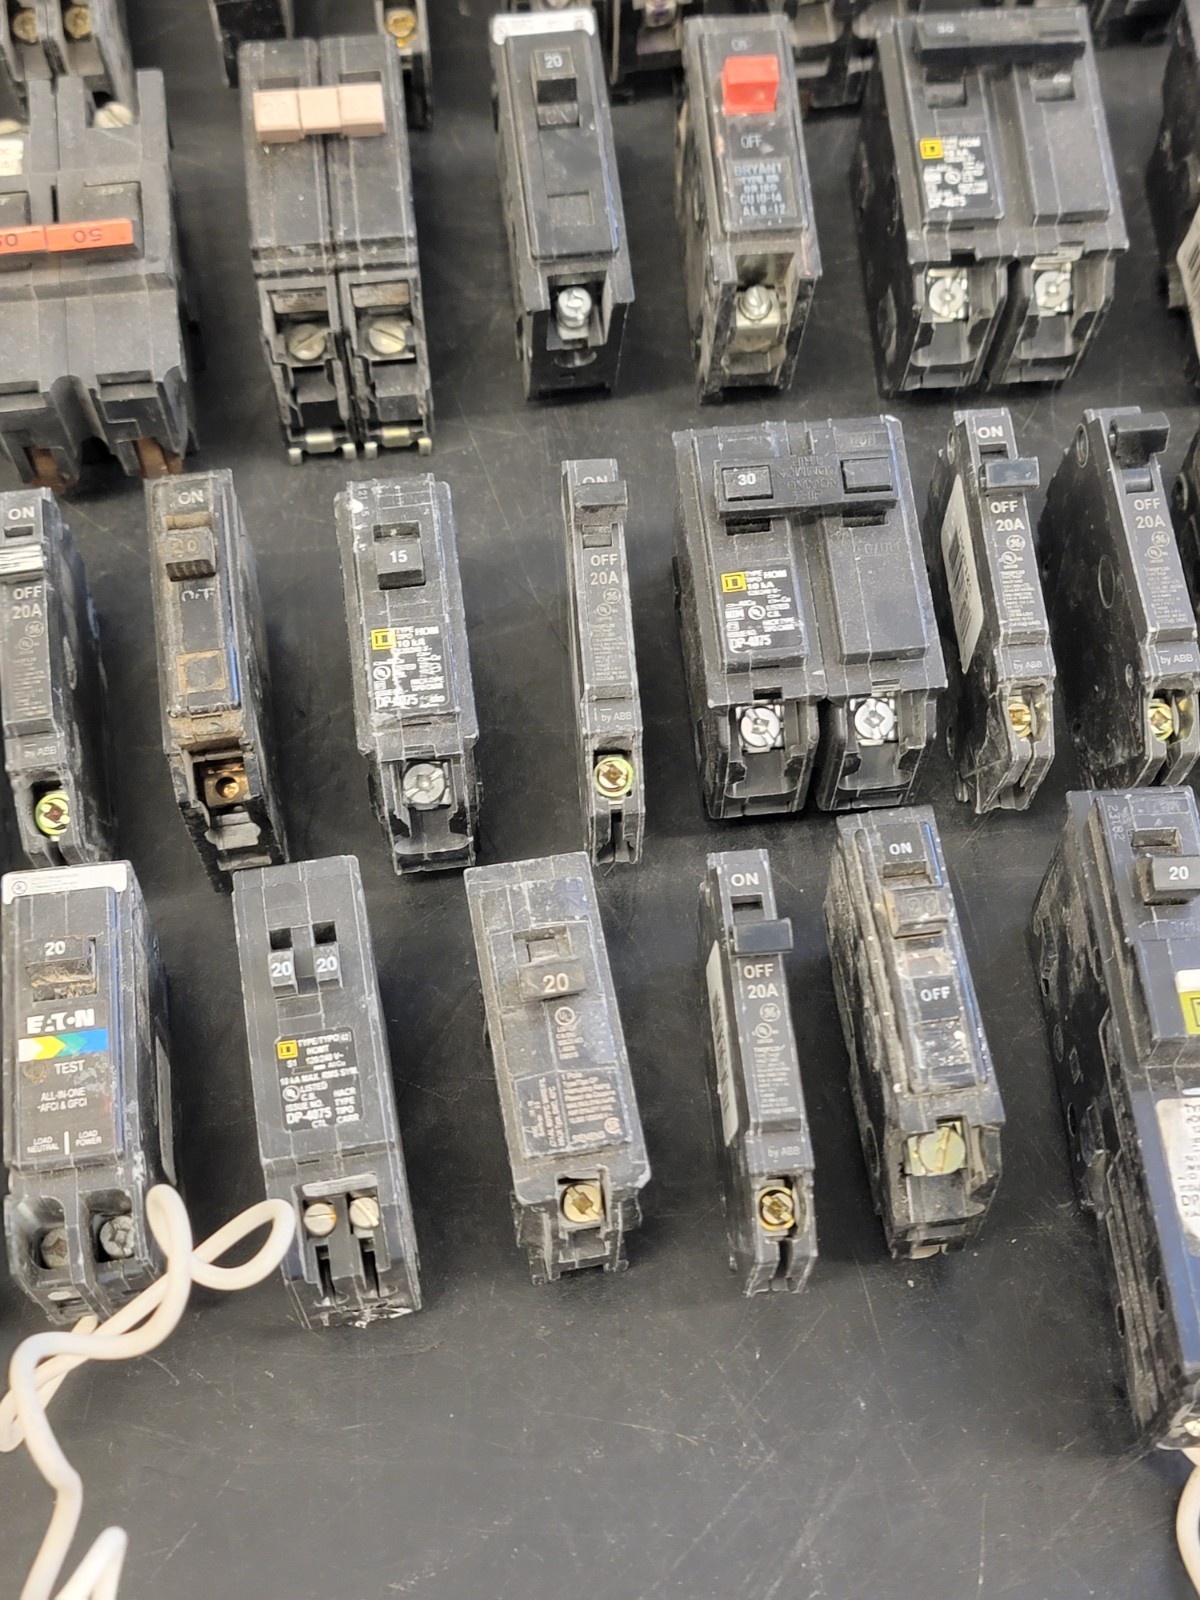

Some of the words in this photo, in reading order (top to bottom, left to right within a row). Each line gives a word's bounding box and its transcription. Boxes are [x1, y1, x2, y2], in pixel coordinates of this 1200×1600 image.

[543, 52, 564, 69] 20
[740, 133, 763, 149] OFF
[734, 163, 782, 176] BRYANT
[743, 205, 759, 217] AL
[72, 228, 102, 243] 50
[977, 426, 1004, 438] ON
[737, 473, 757, 486] 30
[178, 490, 204, 505] ON
[1133, 498, 1161, 511] OFF
[8, 506, 35, 520] ON
[990, 501, 1018, 514] OFF
[996, 518, 1025, 532] 20A
[1136, 514, 1166, 529] 20A
[389, 549, 408, 563] 15
[590, 554, 618, 567] OFF
[590, 571, 619, 586] 20A
[13, 586, 42, 600] OFF
[12, 603, 43, 619] 20A
[1025, 660, 1043, 669] ABB
[1160, 656, 1171, 666] by
[1173, 653, 1194, 663] ABB
[601, 713, 612, 723] by
[613, 711, 633, 721] ABB
[37, 745, 57, 756] ABB
[889, 843, 913, 855] ON
[731, 872, 760, 886] ON
[1169, 865, 1190, 880] 20
[44, 940, 66, 956] 20
[271, 960, 293, 978] 20
[317, 955, 338, 973] 20
[743, 963, 774, 979] OFF
[542, 972, 569, 993] 20
[747, 982, 779, 999] 20A
[920, 986, 951, 1001] OFF
[26, 1008, 95, 1034] EATON
[54, 1060, 85, 1075] TEST
[300, 1080, 328, 1093] LISTED
[333, 1086, 357, 1097] HACR
[41, 1087, 86, 1101] ALL-IN-ONE
[334, 1096, 356, 1106] TYPE
[67, 1098, 88, 1109] GFCI
[33, 1136, 53, 1146] LOAD
[75, 1136, 102, 1147] POWER
[79, 1130, 98, 1139] LOAD
[26, 1142, 60, 1154] NEUTRAL
[780, 1146, 801, 1156] ABB
